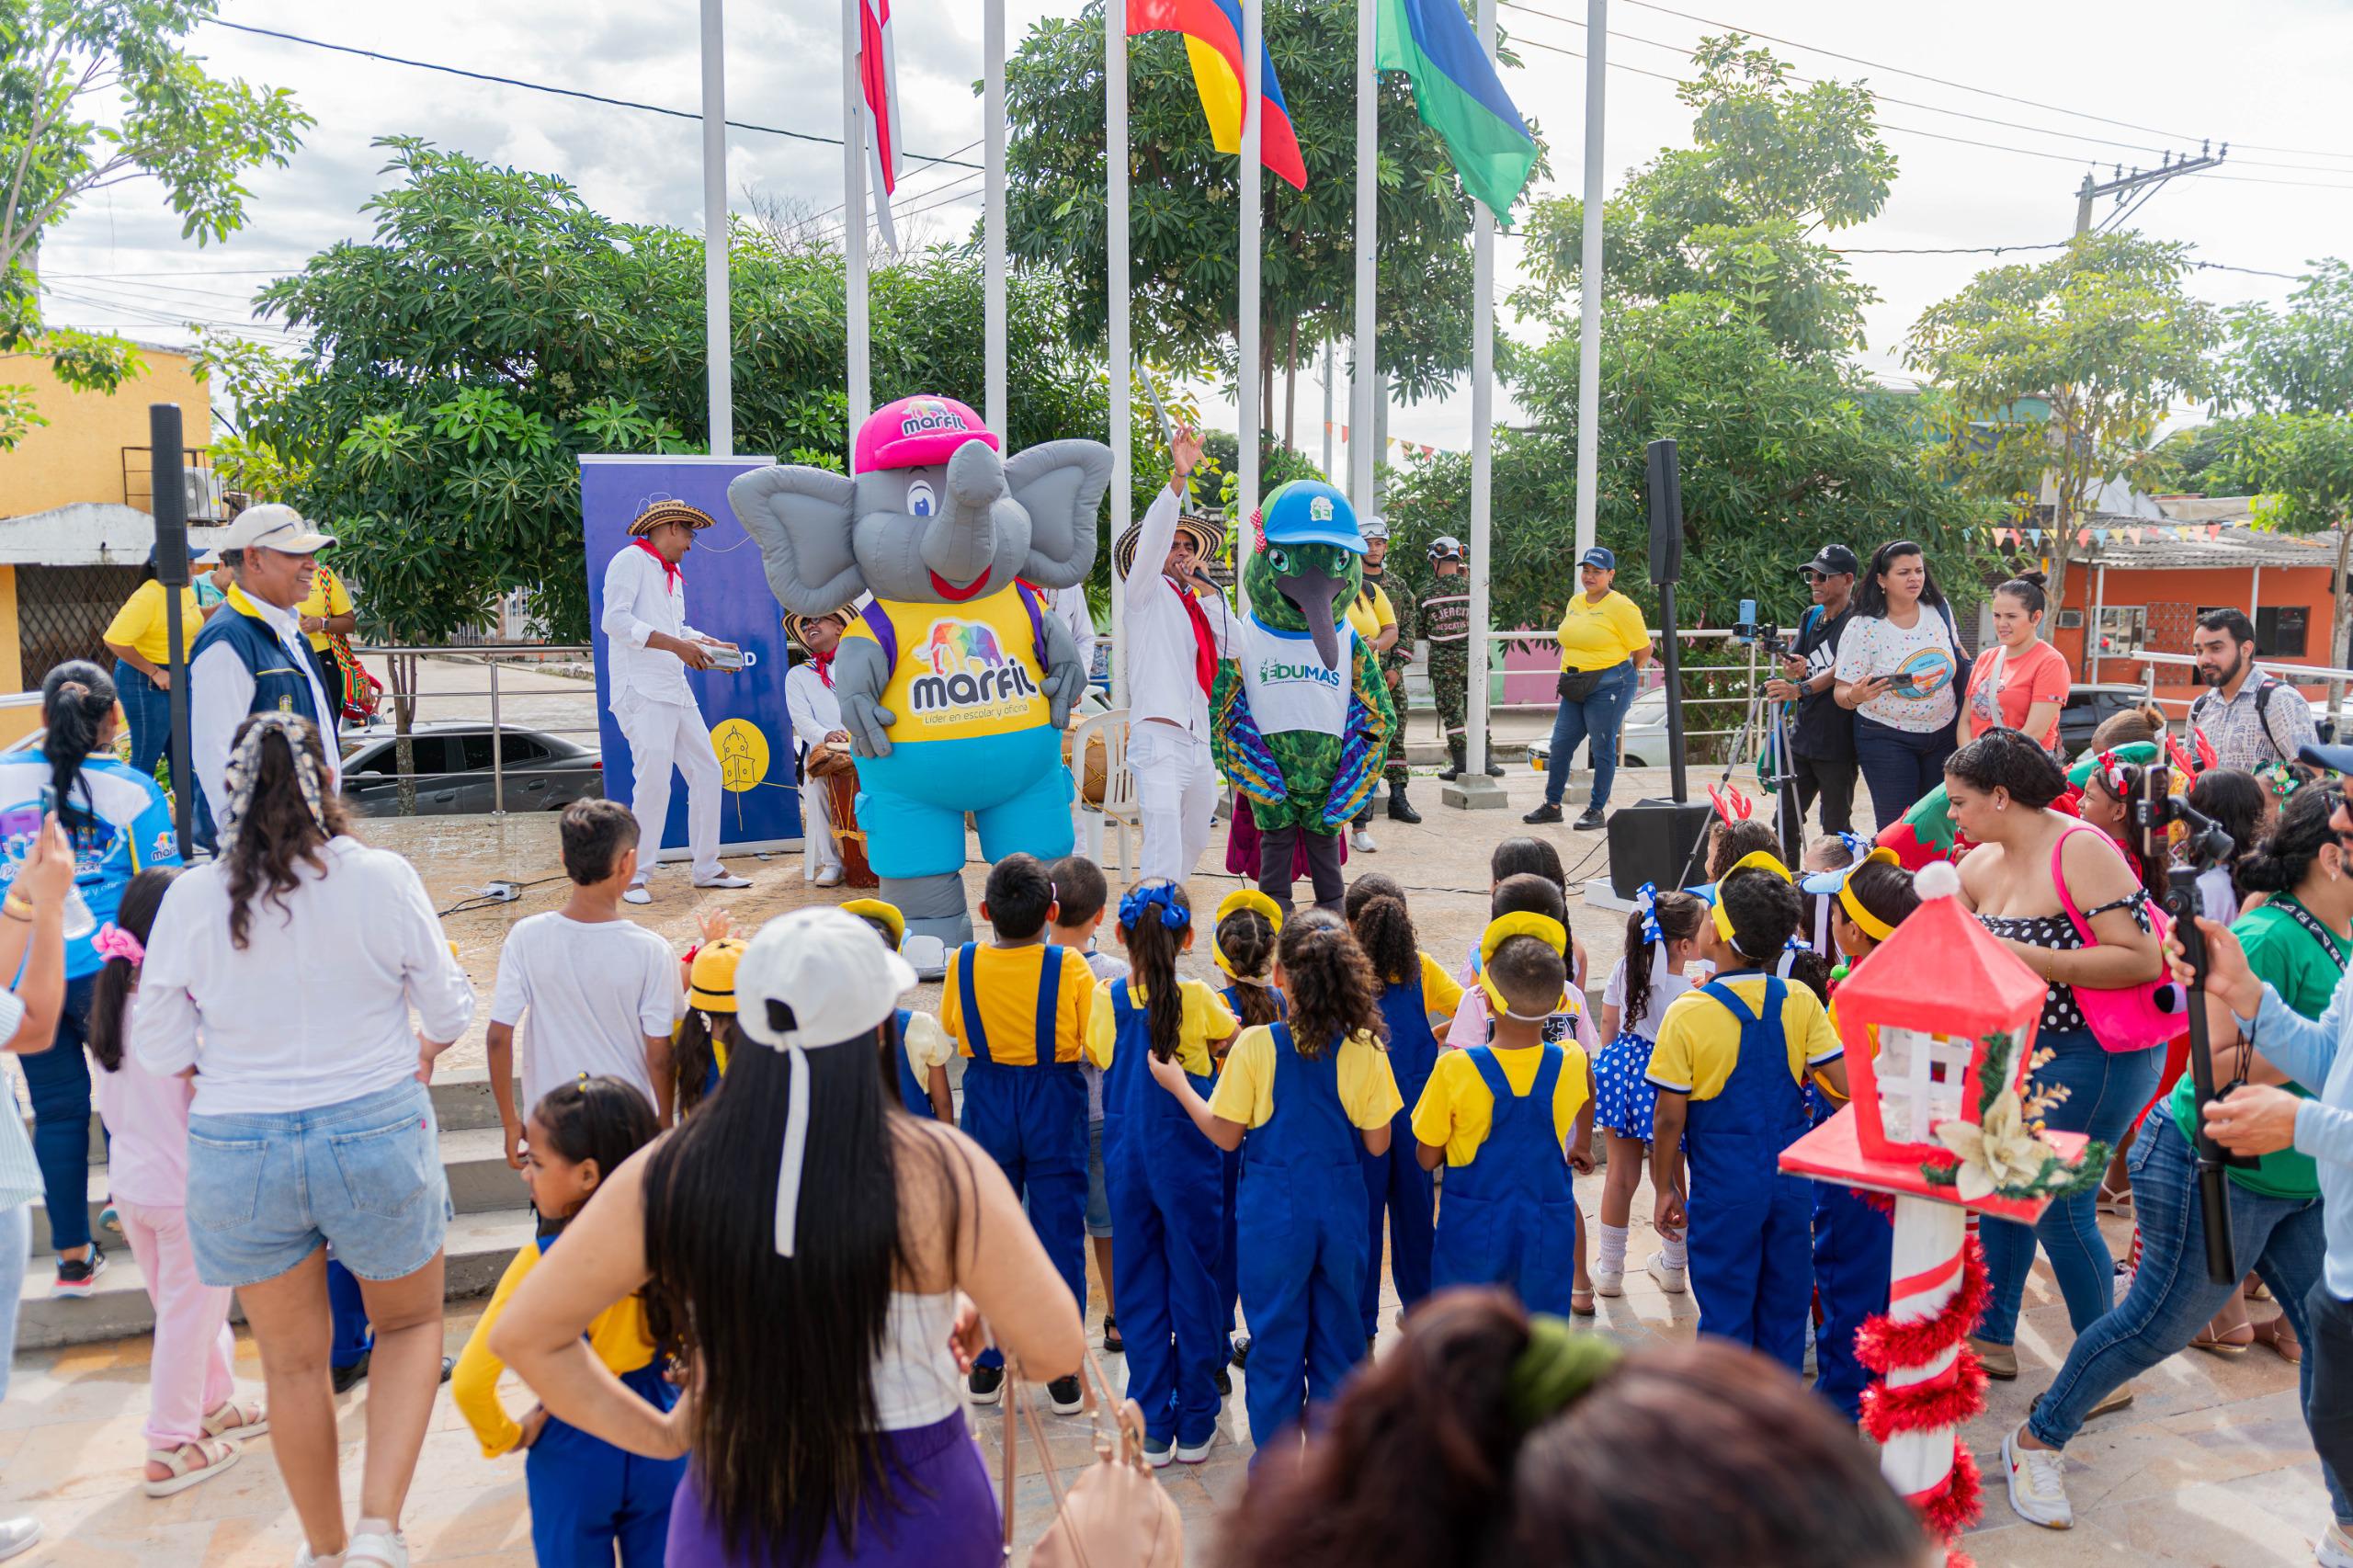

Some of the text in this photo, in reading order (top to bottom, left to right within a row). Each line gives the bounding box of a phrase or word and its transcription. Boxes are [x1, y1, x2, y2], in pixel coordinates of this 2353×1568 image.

[903, 414, 967, 435] marfil
[1431, 607, 1470, 621] EJERCIT
[914, 658, 1037, 710] marfil
[1268, 663, 1341, 687] EDUMAS
[949, 713, 961, 722] en
[963, 708, 995, 721] escolar
[996, 708, 1003, 717] y
[1005, 704, 1029, 714] oficina
